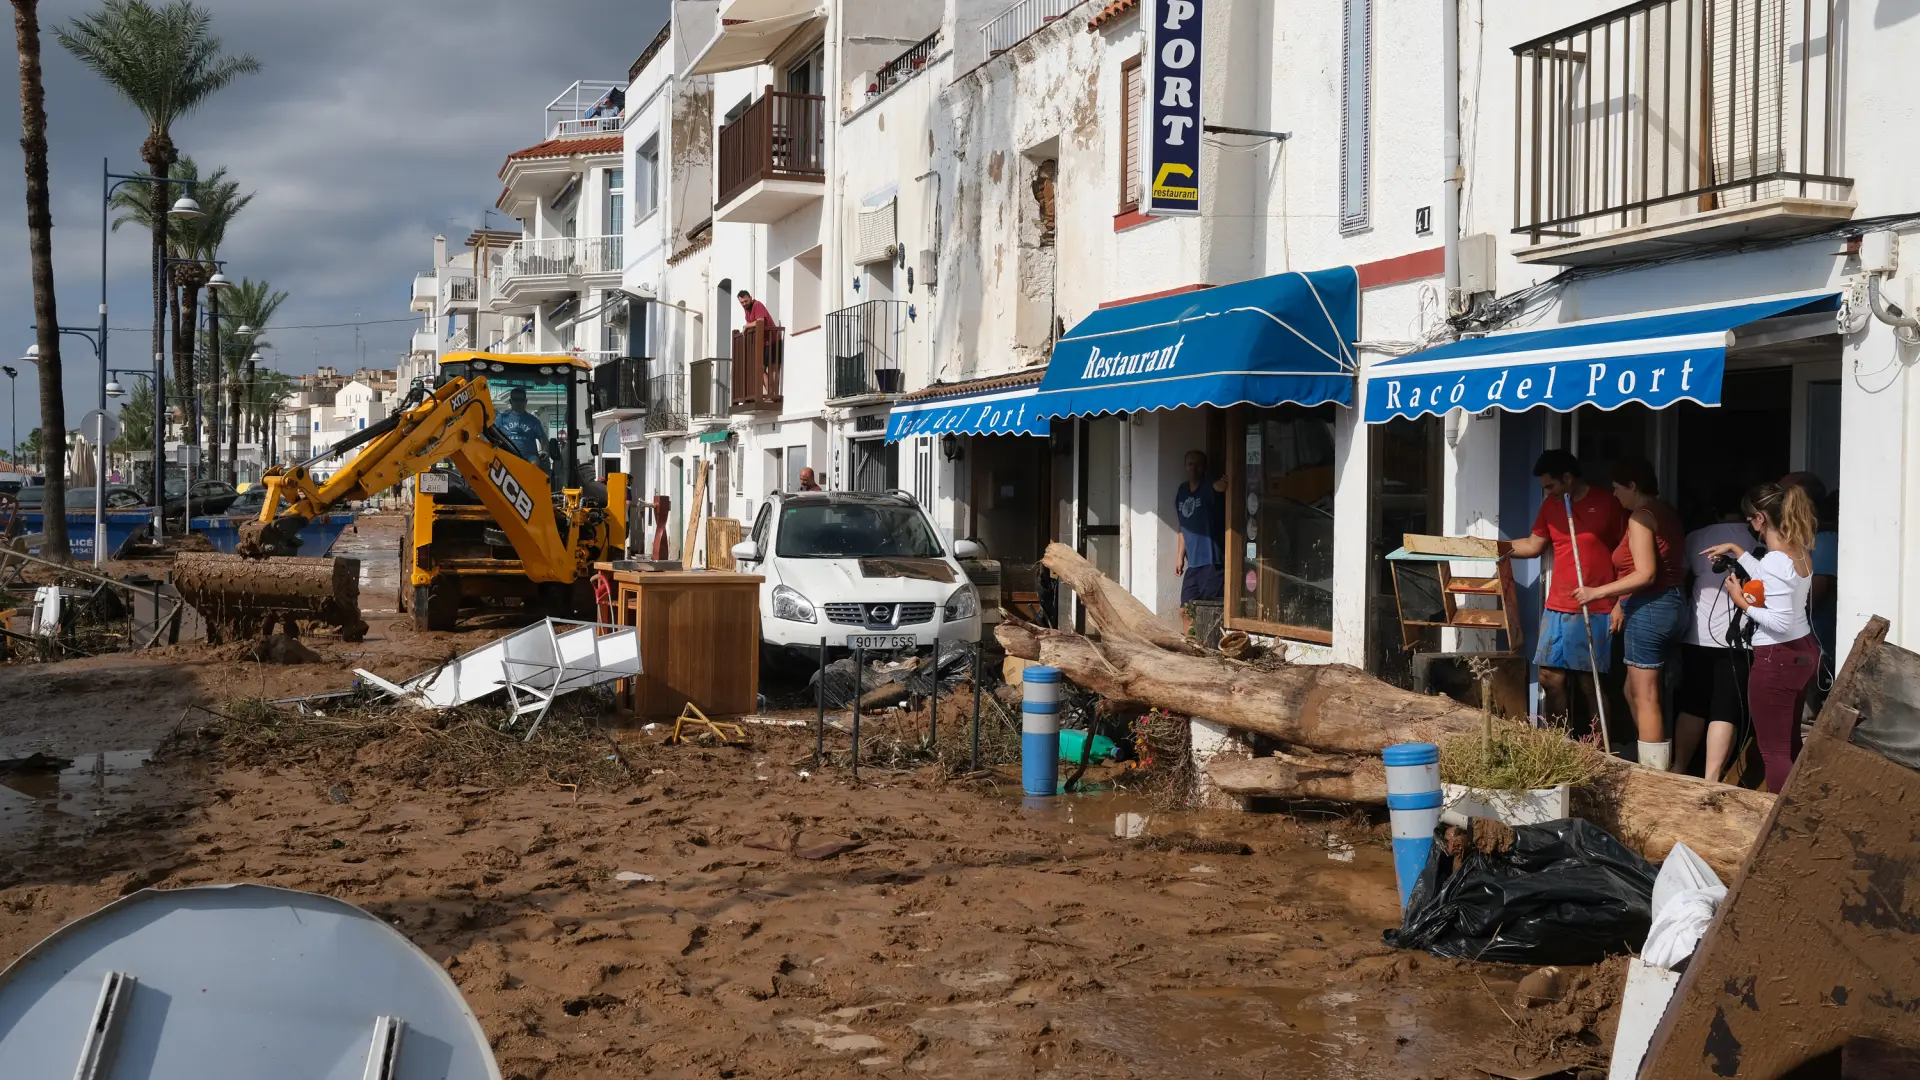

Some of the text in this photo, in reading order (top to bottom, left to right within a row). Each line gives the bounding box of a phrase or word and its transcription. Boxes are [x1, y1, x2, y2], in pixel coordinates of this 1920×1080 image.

[1160, 0, 1195, 146] PORT
[1153, 189, 1196, 199] restaurant
[1416, 208, 1429, 232] 41
[1080, 334, 1186, 380] Restaurant
[1385, 358, 1694, 409] Racó del Port
[893, 411, 934, 436] Racó
[933, 407, 972, 429] del
[974, 402, 1026, 428] Port
[429, 474, 446, 482] 5770
[490, 466, 533, 520] JCB
[69, 538, 94, 547] LICÉ
[856, 636, 914, 648] 9017 GSS
